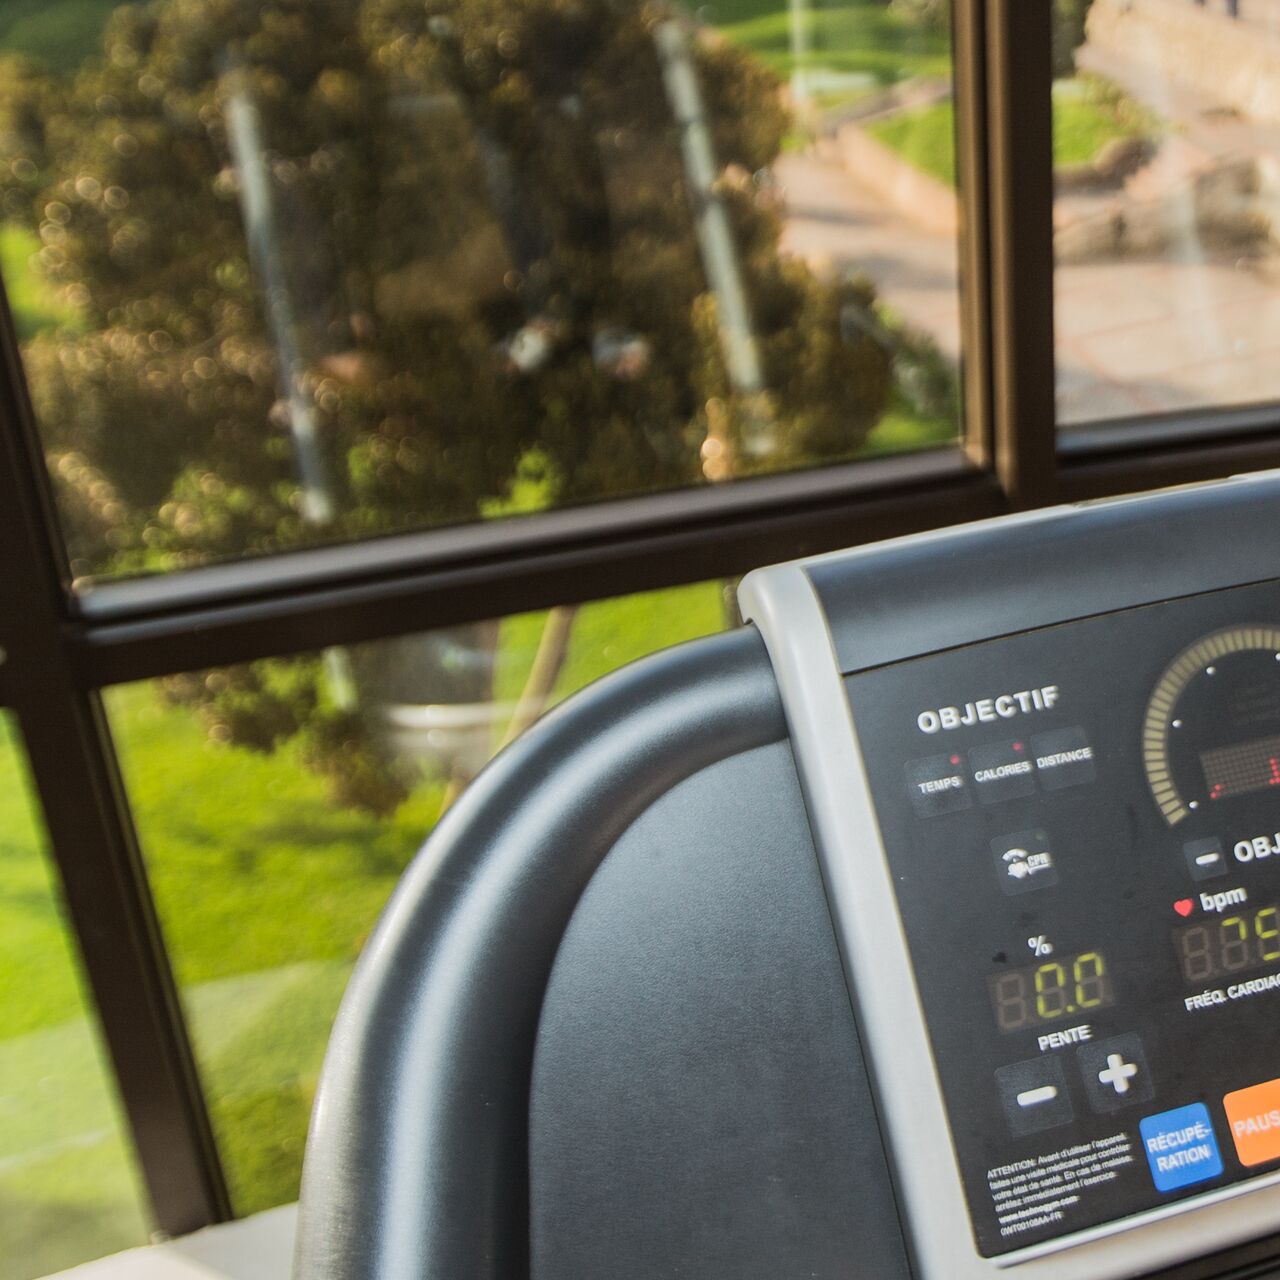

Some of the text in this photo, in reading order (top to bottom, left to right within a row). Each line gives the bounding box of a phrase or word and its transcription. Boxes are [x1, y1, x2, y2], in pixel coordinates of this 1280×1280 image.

[918, 685, 1060, 734] OBJECTIF
[974, 760, 1033, 783] CALORIES
[1037, 747, 1093, 770] DISTANCE
[918, 775, 963, 795] TEMPS
[1200, 887, 1246, 914] bpm
[1028, 935, 1054, 956] %
[1184, 984, 1227, 1011] FRÉQ.
[1038, 1025, 1092, 1052] PENTE
[1147, 1123, 1213, 1154] RÉCUPÉ-
[1156, 1145, 1210, 1173] RATION
